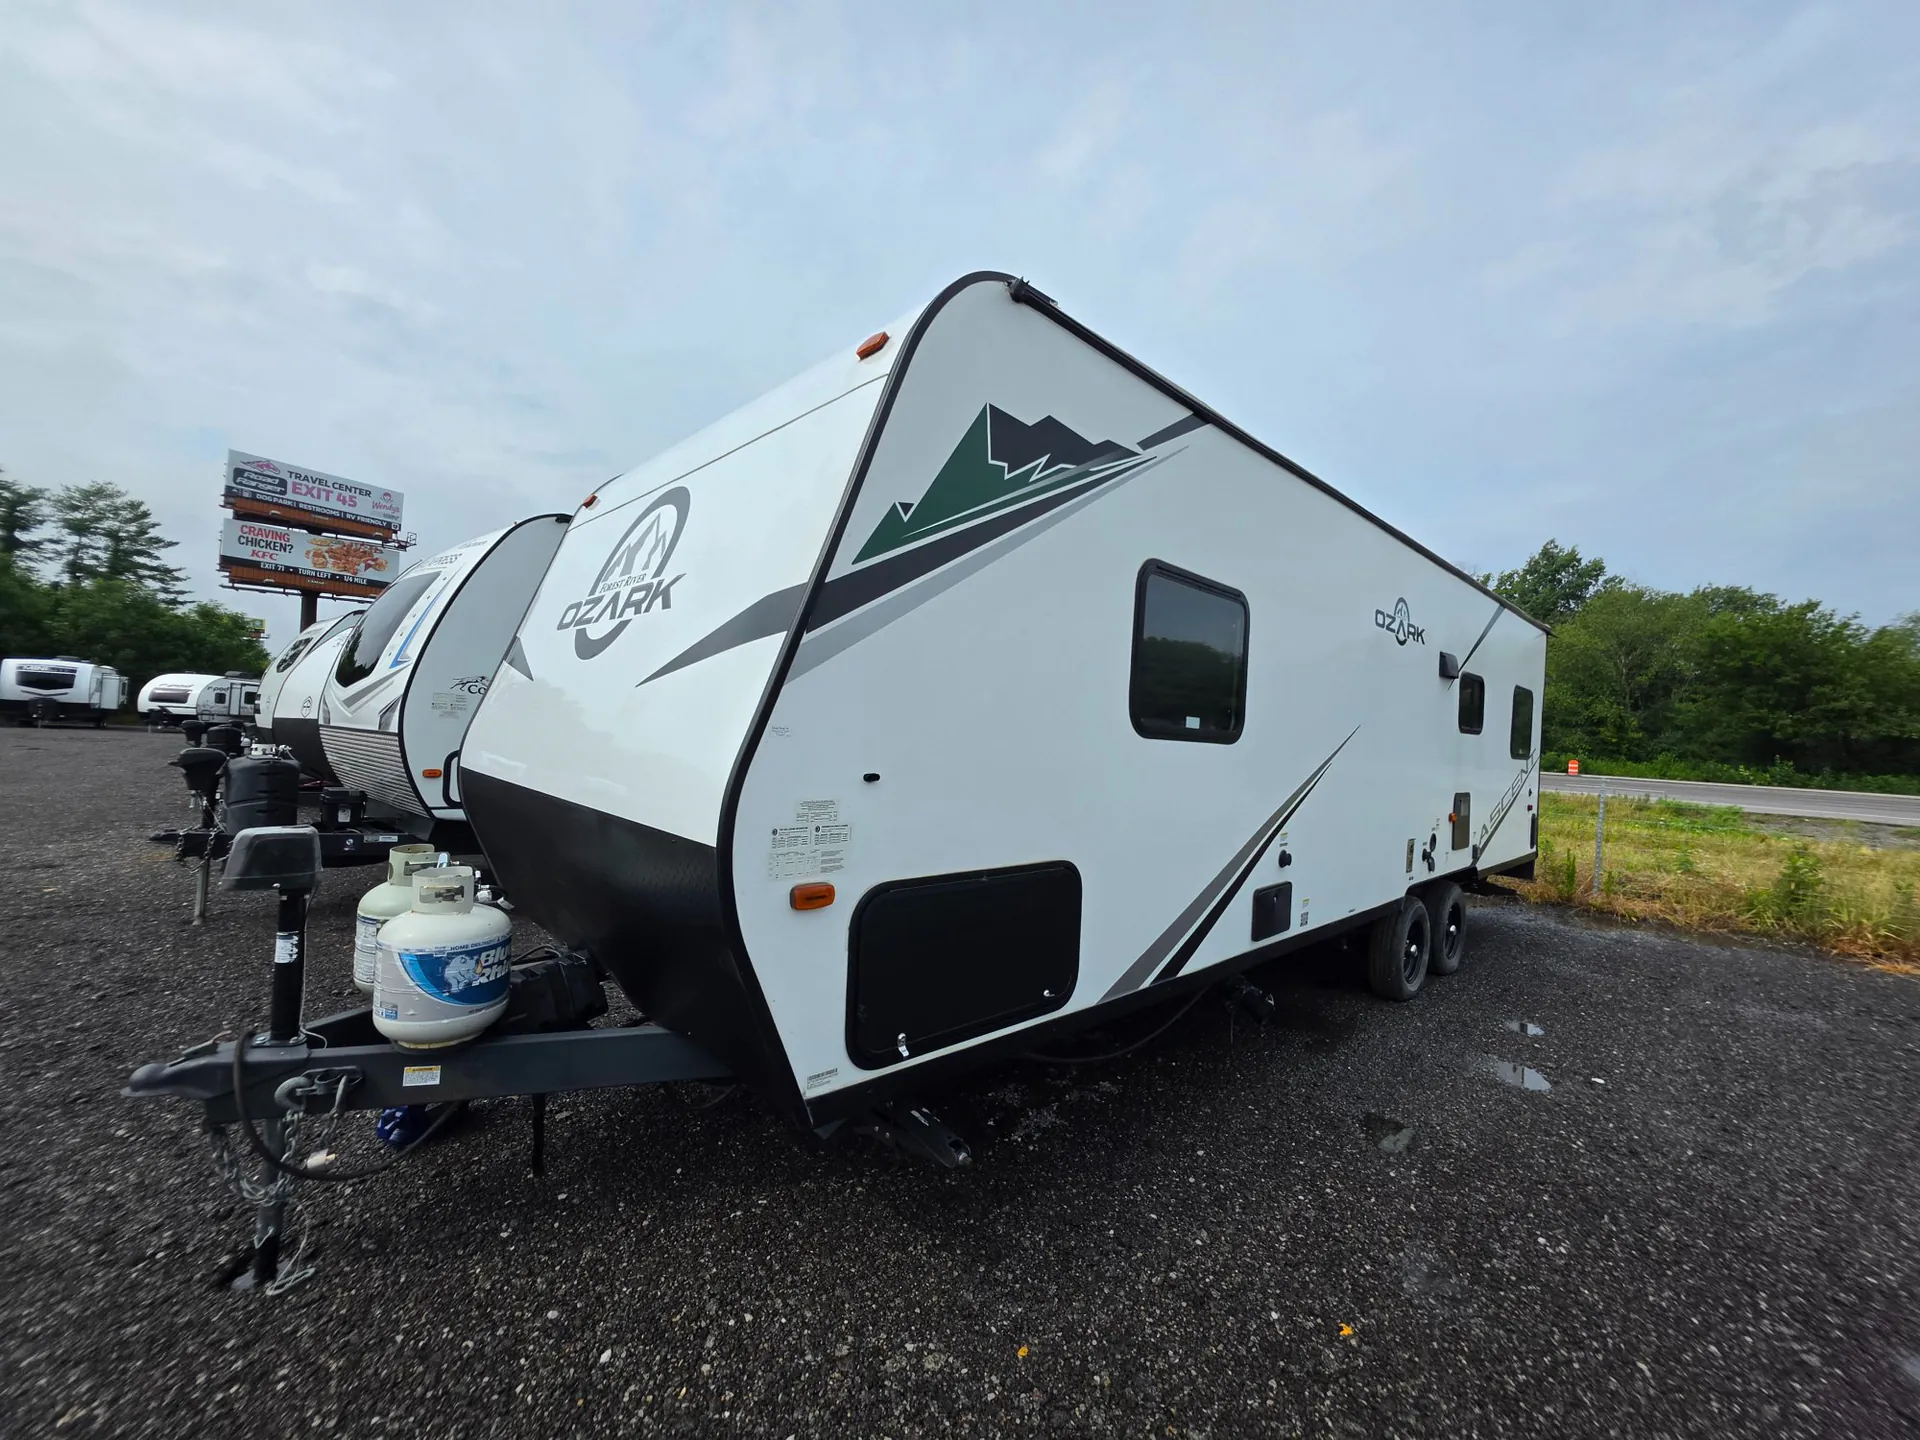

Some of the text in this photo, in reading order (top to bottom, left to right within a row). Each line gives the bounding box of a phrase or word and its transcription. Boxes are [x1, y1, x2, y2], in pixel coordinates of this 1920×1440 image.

[236, 477, 285, 493] Ranger
[243, 471, 280, 485] Road
[287, 470, 372, 498] TRAVEL CENTER
[291, 480, 358, 508] EXIT 45
[256, 493, 273, 502] DOG
[273, 497, 293, 506] PARK
[299, 502, 340, 517] RESTROOMS
[346, 513, 356, 522] RV
[357, 515, 388, 527] FRIENDLY
[237, 535, 294, 554] CHICKEN?
[240, 524, 291, 543] CRAVING
[250, 549, 279, 561] KFC
[260, 562, 276, 570] EXIT
[298, 568, 316, 577] TURN
[316, 570, 332, 579] LEFT
[343, 575, 353, 583] 1/4
[354, 576, 368, 585] MILE
[599, 573, 647, 594] FOREST RIVER
[556, 572, 688, 631] OZARK
[1375, 608, 1426, 645] OZARK
[1479, 747, 1537, 846] ASCENT
[481, 945, 511, 966] Blu
